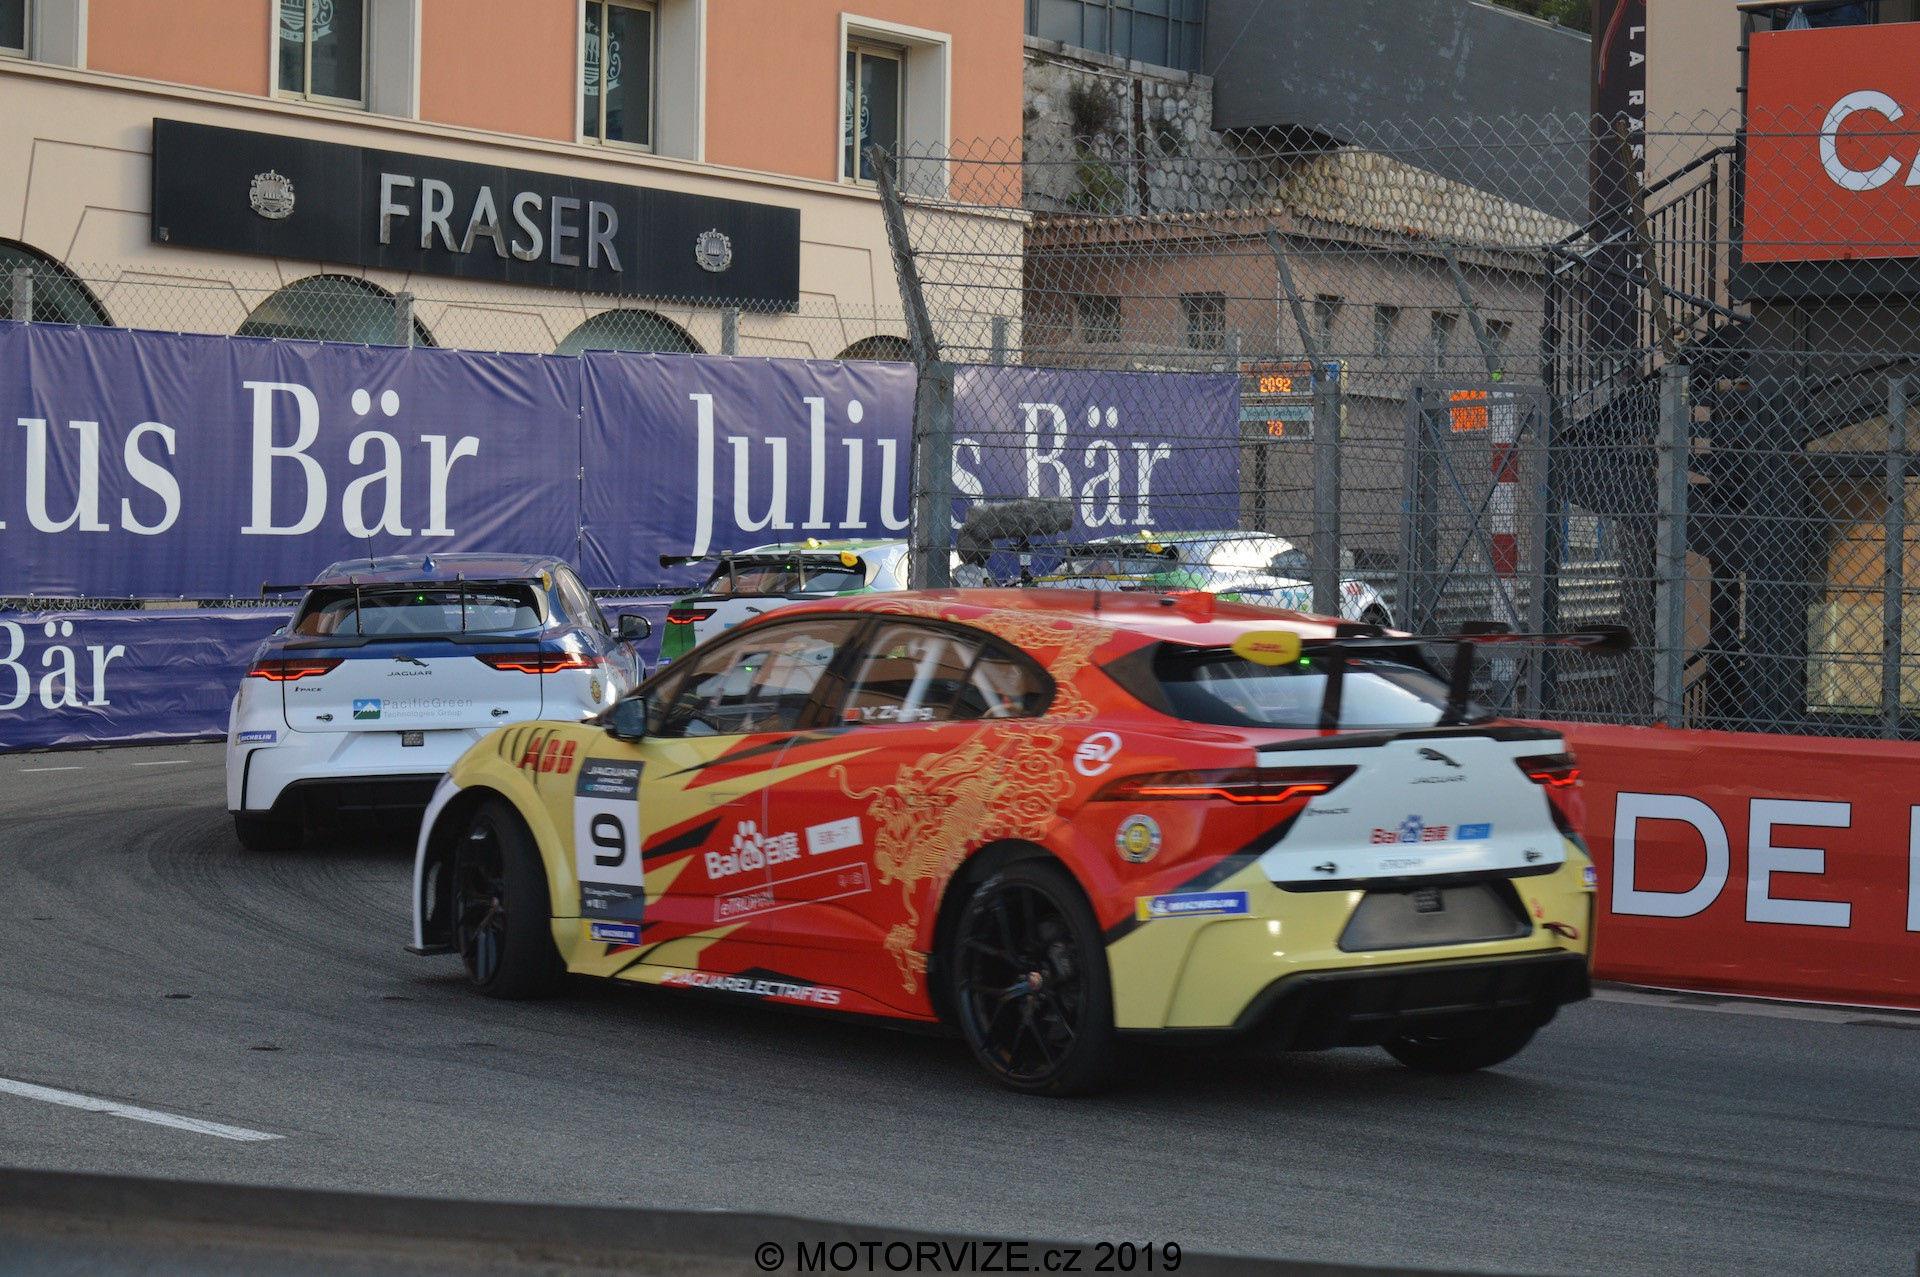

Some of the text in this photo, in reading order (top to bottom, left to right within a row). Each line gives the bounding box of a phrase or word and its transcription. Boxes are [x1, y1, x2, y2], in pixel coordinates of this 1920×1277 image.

[1629, 26, 1645, 67] LA
[1820, 90, 1920, 191] C
[380, 172, 623, 273] FRASER
[1260, 377, 1291, 393] 2092
[1267, 421, 1283, 437] 73
[0, 381, 480, 539] us Bär
[1019, 402, 1172, 529] Bär
[384, 710, 463, 718] Technologies Group
[517, 736, 578, 775] ABB
[586, 765, 639, 779] JAGUAR
[590, 812, 627, 867] 9
[1611, 792, 1851, 928] DE
